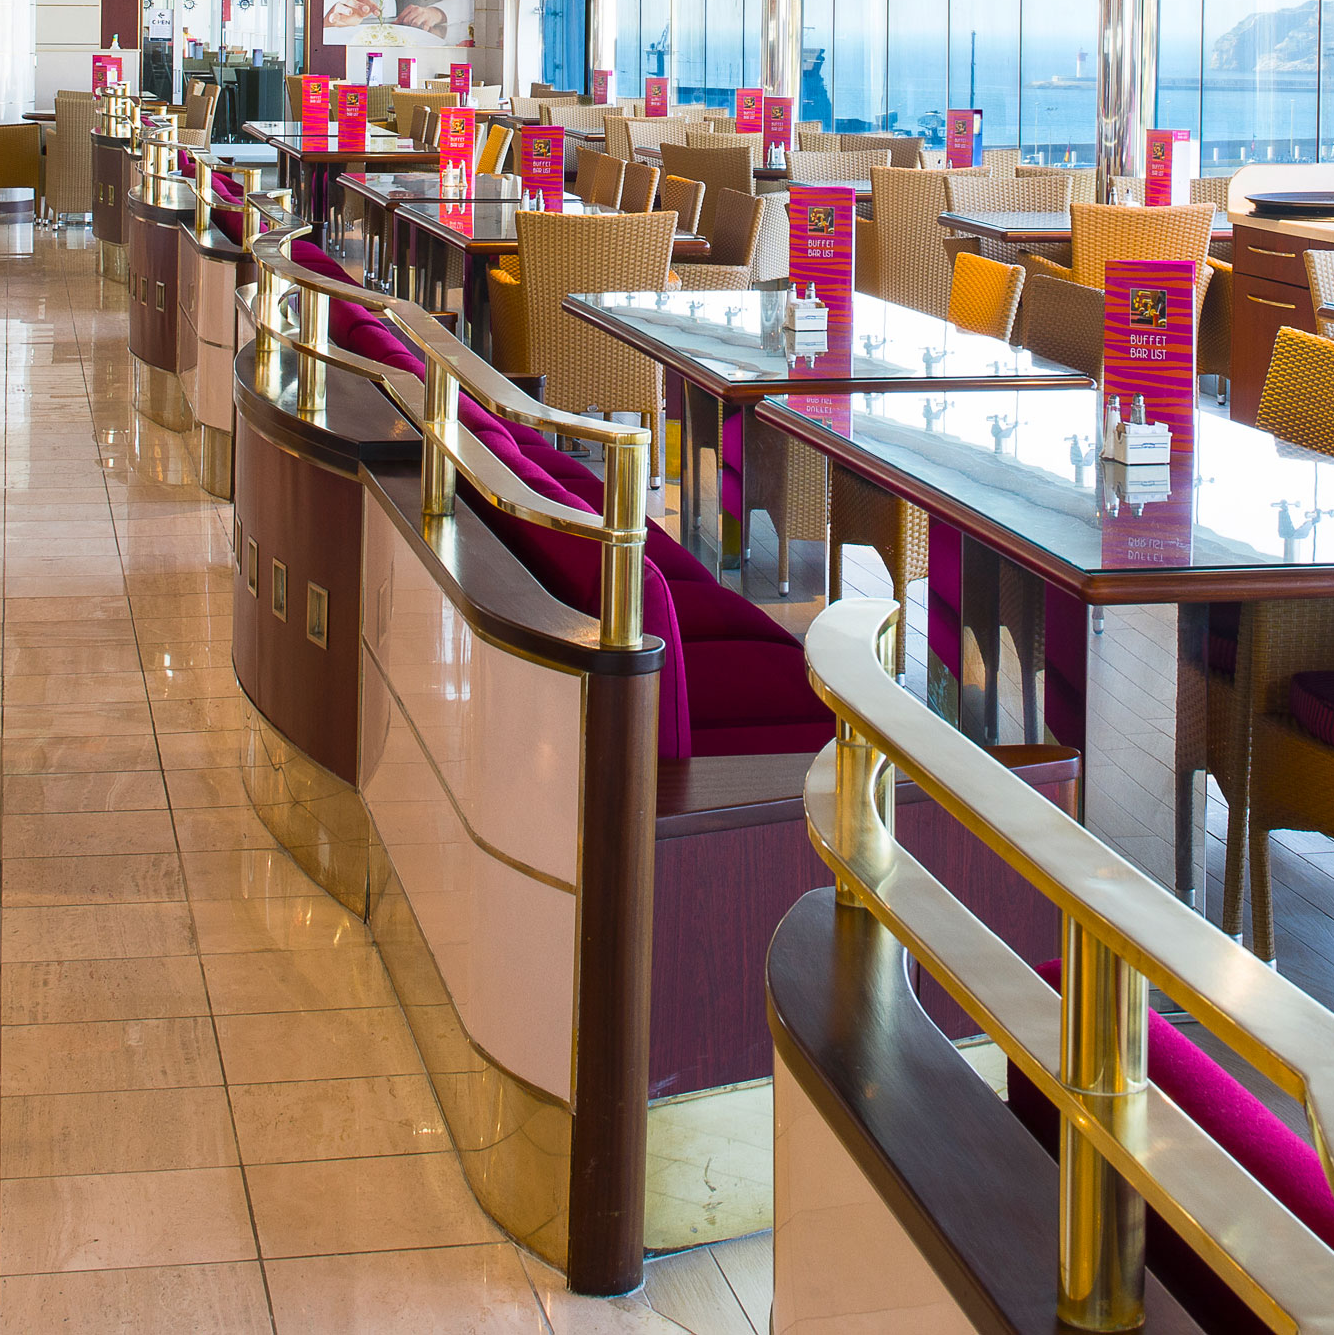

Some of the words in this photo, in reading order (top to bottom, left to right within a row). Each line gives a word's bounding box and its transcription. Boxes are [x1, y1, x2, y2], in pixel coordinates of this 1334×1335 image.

[807, 239, 834, 248] BUFFET
[807, 248, 821, 257] BAR
[822, 249, 834, 258] LIST
[1130, 334, 1167, 346] BUFFET
[1130, 347, 1148, 359] BAR
[1150, 349, 1167, 360] LIST
